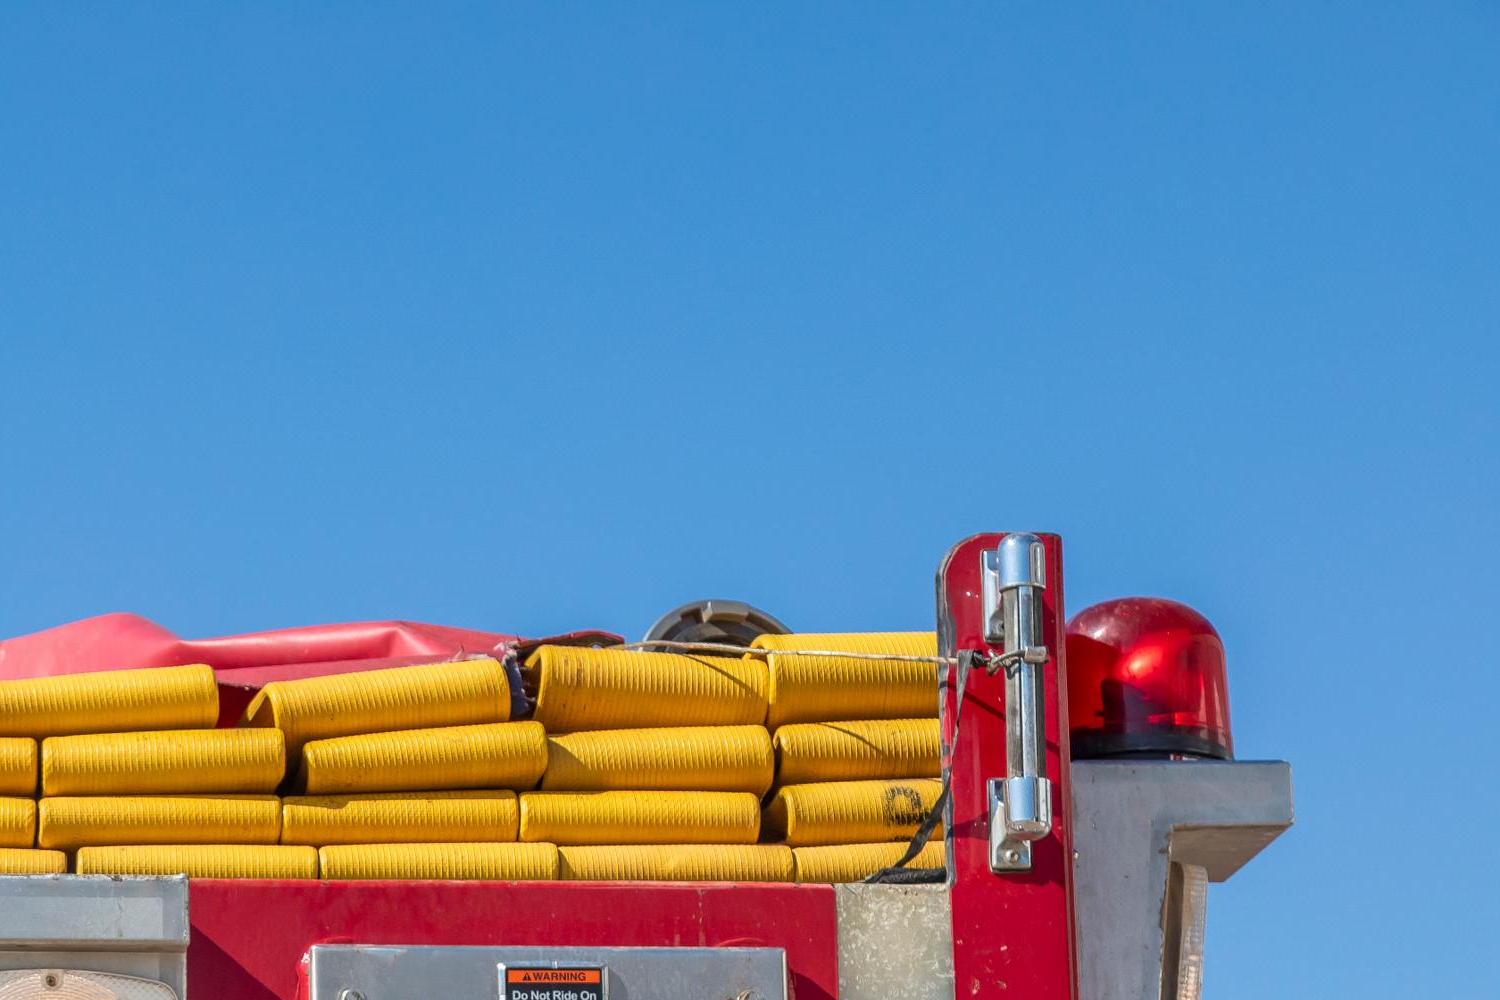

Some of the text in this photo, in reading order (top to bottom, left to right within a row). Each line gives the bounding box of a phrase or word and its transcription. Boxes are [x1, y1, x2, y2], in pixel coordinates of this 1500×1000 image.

[533, 972, 587, 981] WARNING
[512, 990, 597, 1000] Do Not Ride On
